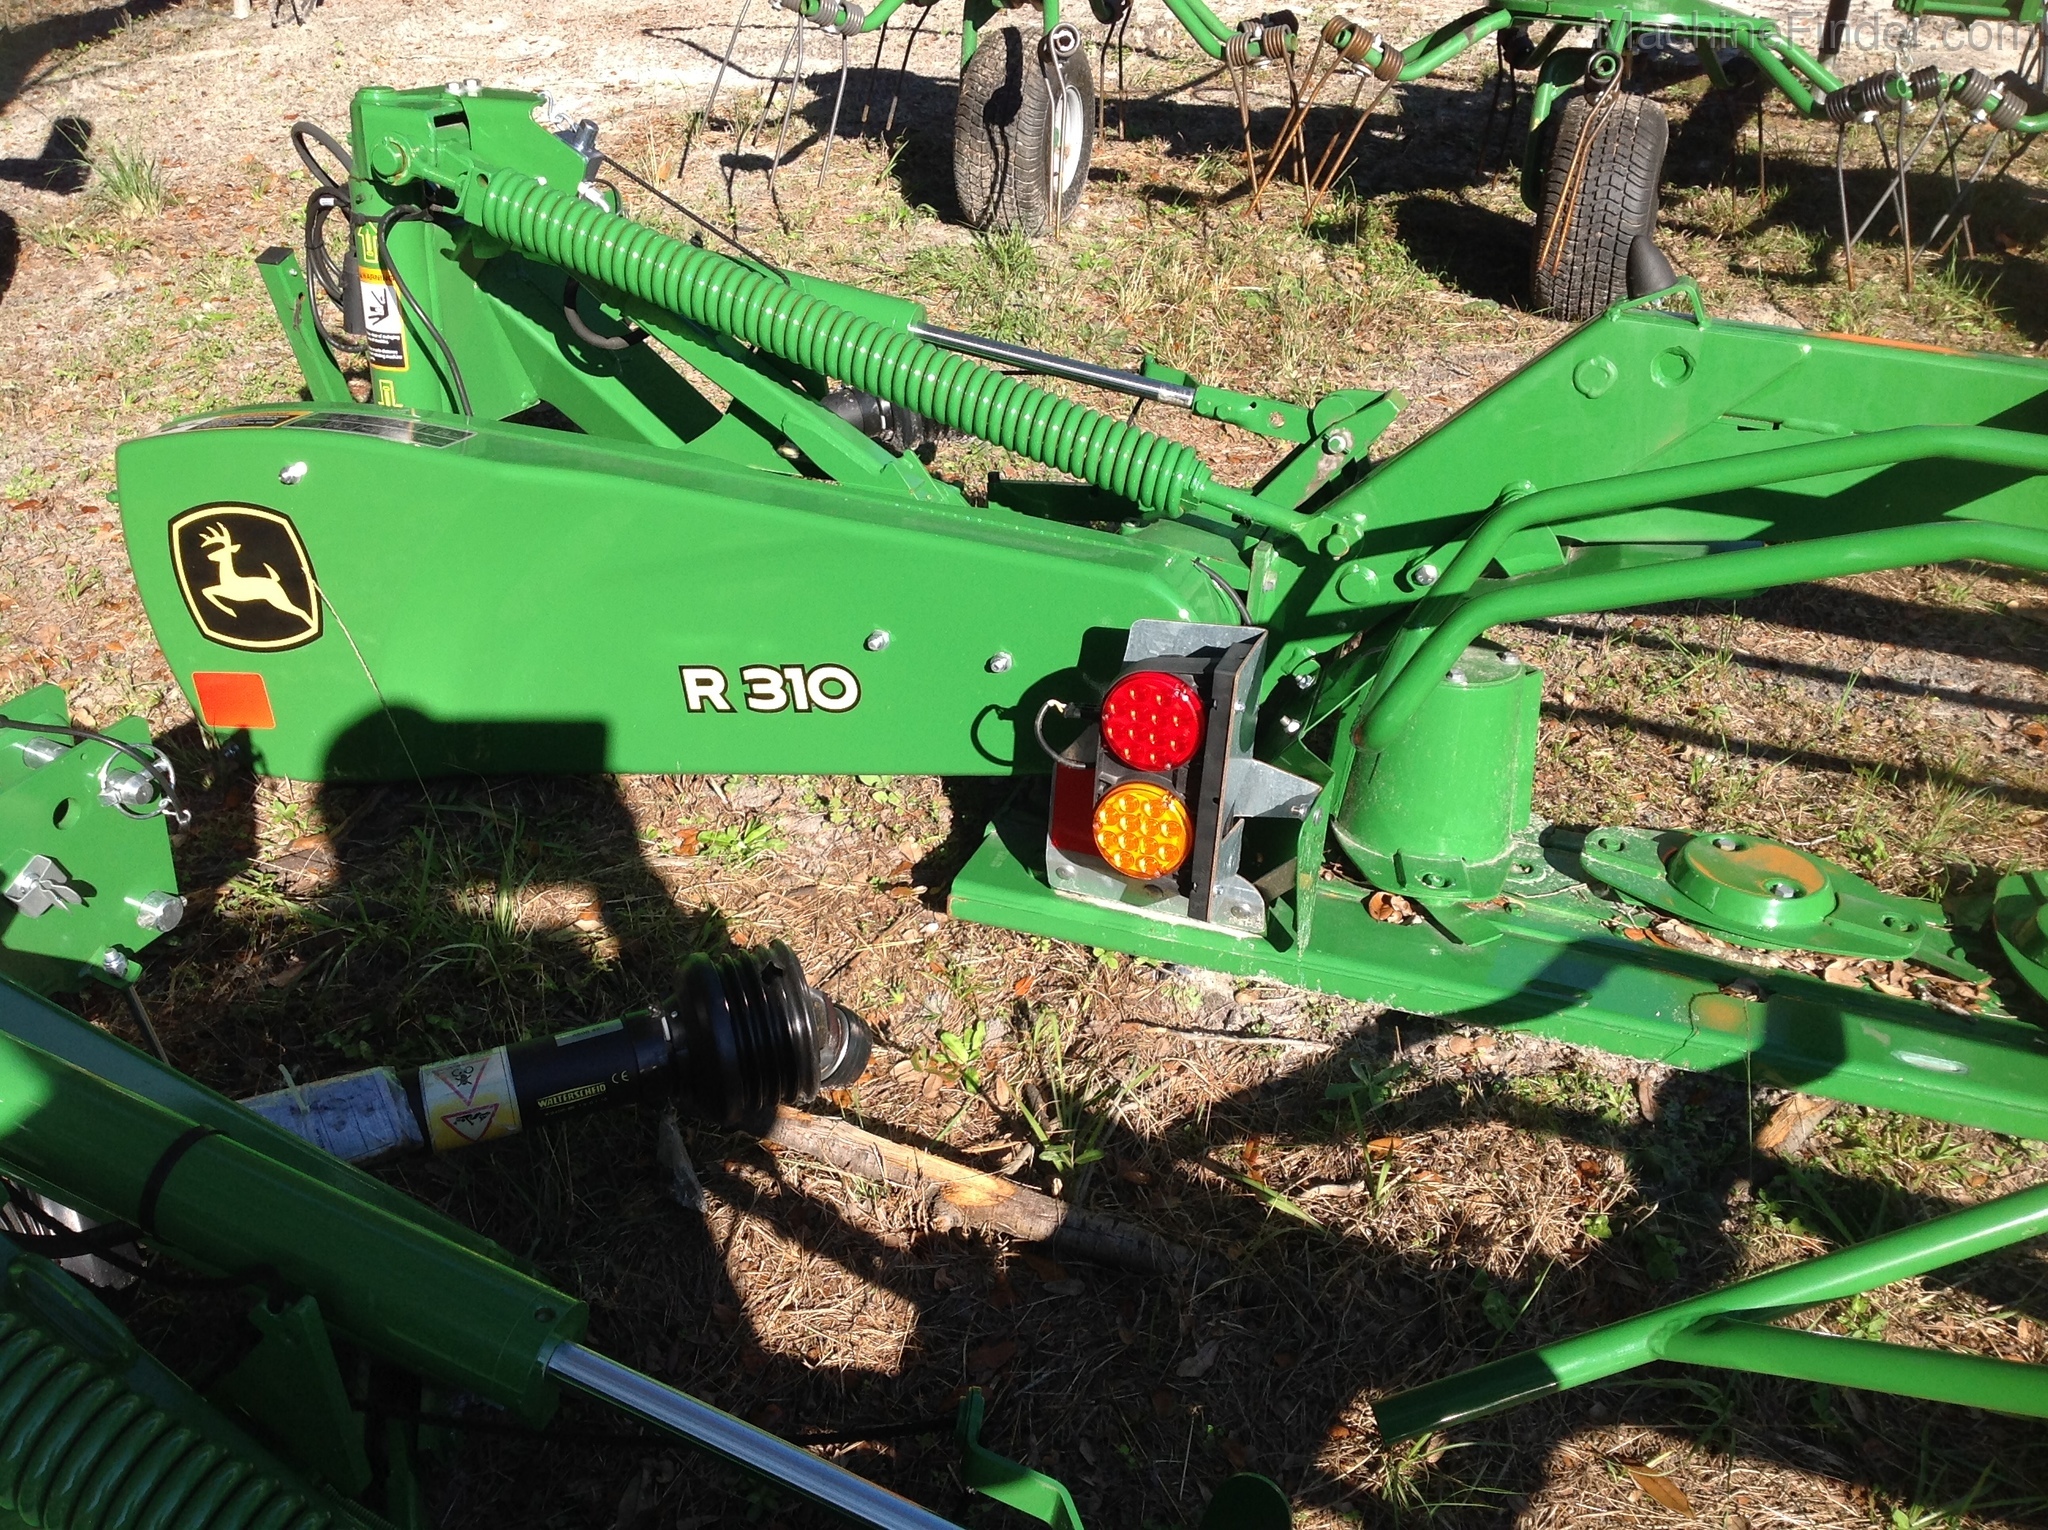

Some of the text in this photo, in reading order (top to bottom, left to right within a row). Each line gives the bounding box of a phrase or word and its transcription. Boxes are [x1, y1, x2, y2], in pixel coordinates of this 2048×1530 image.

[678, 662, 862, 714] R 310
[537, 1083, 607, 1109] WALTERSCHEID
